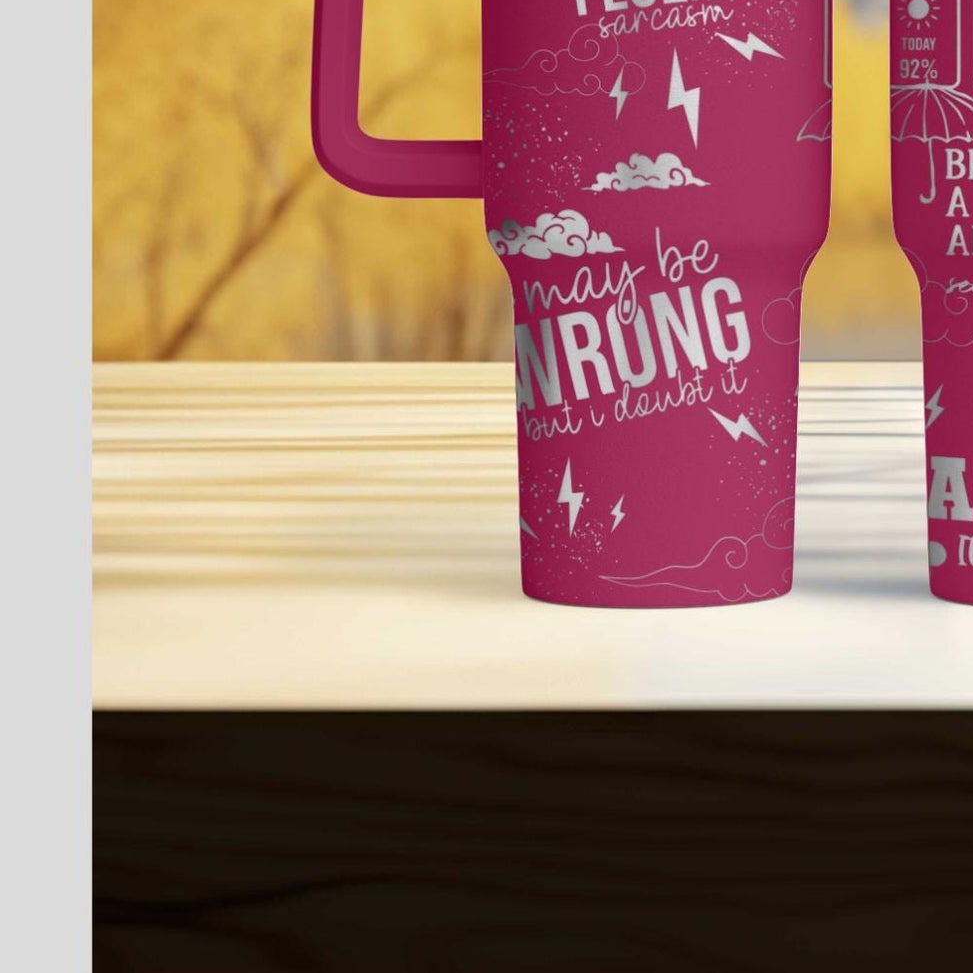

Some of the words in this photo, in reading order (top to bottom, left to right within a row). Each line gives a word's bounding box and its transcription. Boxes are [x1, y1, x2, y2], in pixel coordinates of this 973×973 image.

[599, 1, 734, 38] sarcasm
[902, 37, 936, 51] TODAY
[900, 59, 938, 79] 92%
[945, 187, 969, 218] A
[523, 261, 646, 324] may
[656, 228, 719, 282] be
[514, 277, 751, 411] WRONG
[522, 399, 583, 441] but
[591, 407, 604, 426] i
[615, 369, 713, 422] doubt
[721, 360, 748, 395] it
